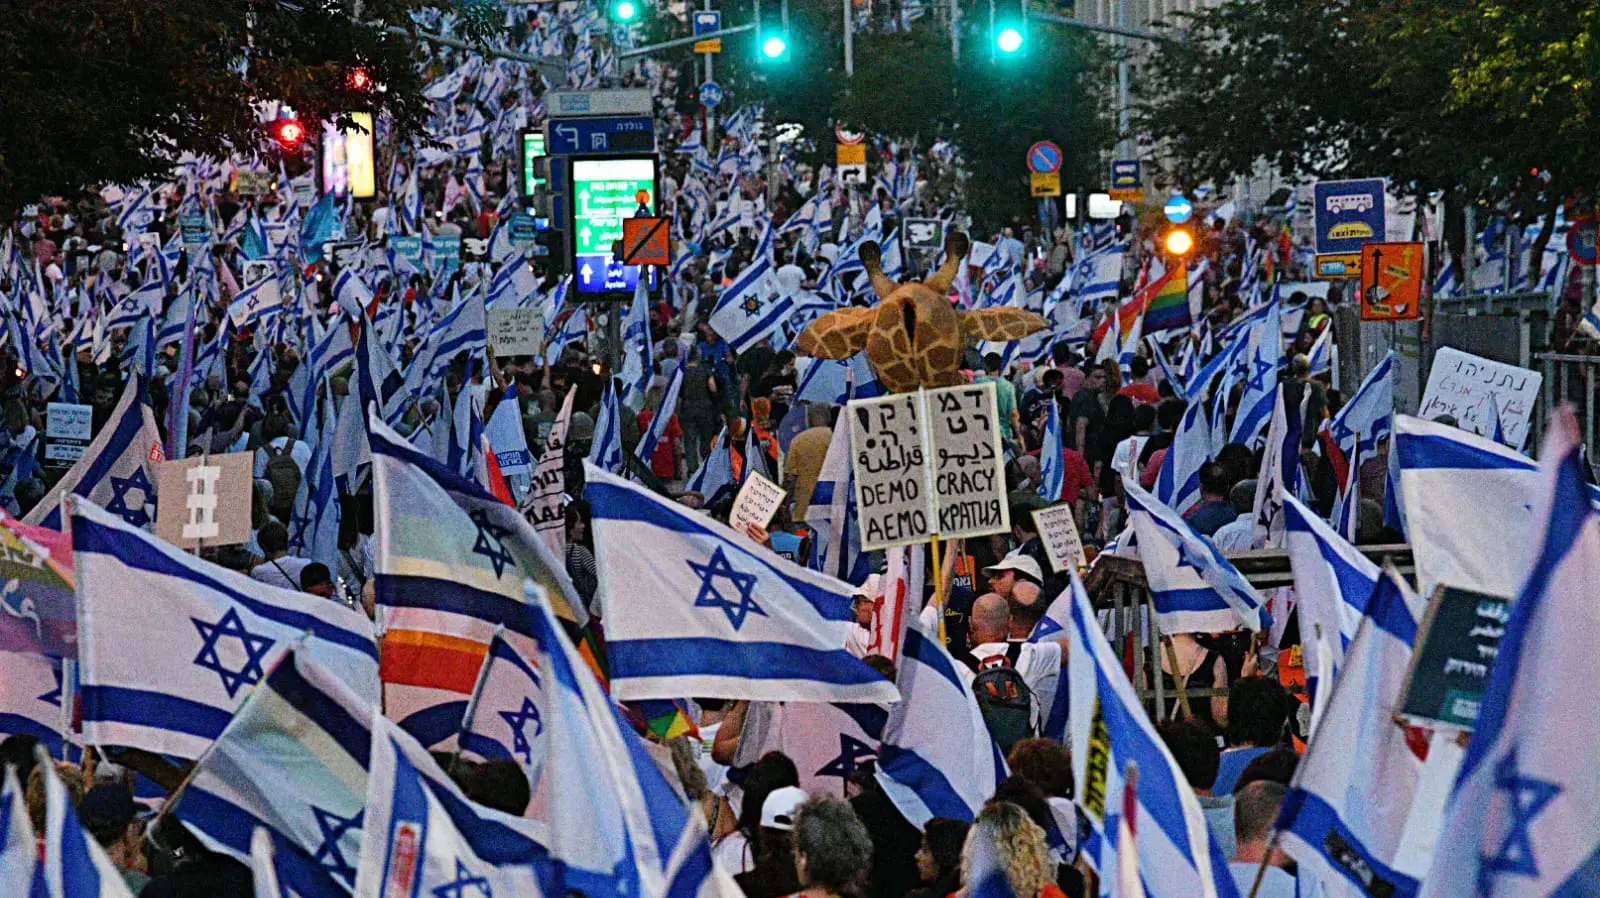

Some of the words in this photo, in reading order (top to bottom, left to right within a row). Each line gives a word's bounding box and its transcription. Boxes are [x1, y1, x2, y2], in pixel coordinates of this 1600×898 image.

[1454, 360, 1528, 391] נתניהו
[861, 478, 919, 507] DEMO
[936, 467, 995, 496] CRACY
[938, 499, 1003, 533] КРАТИЯ
